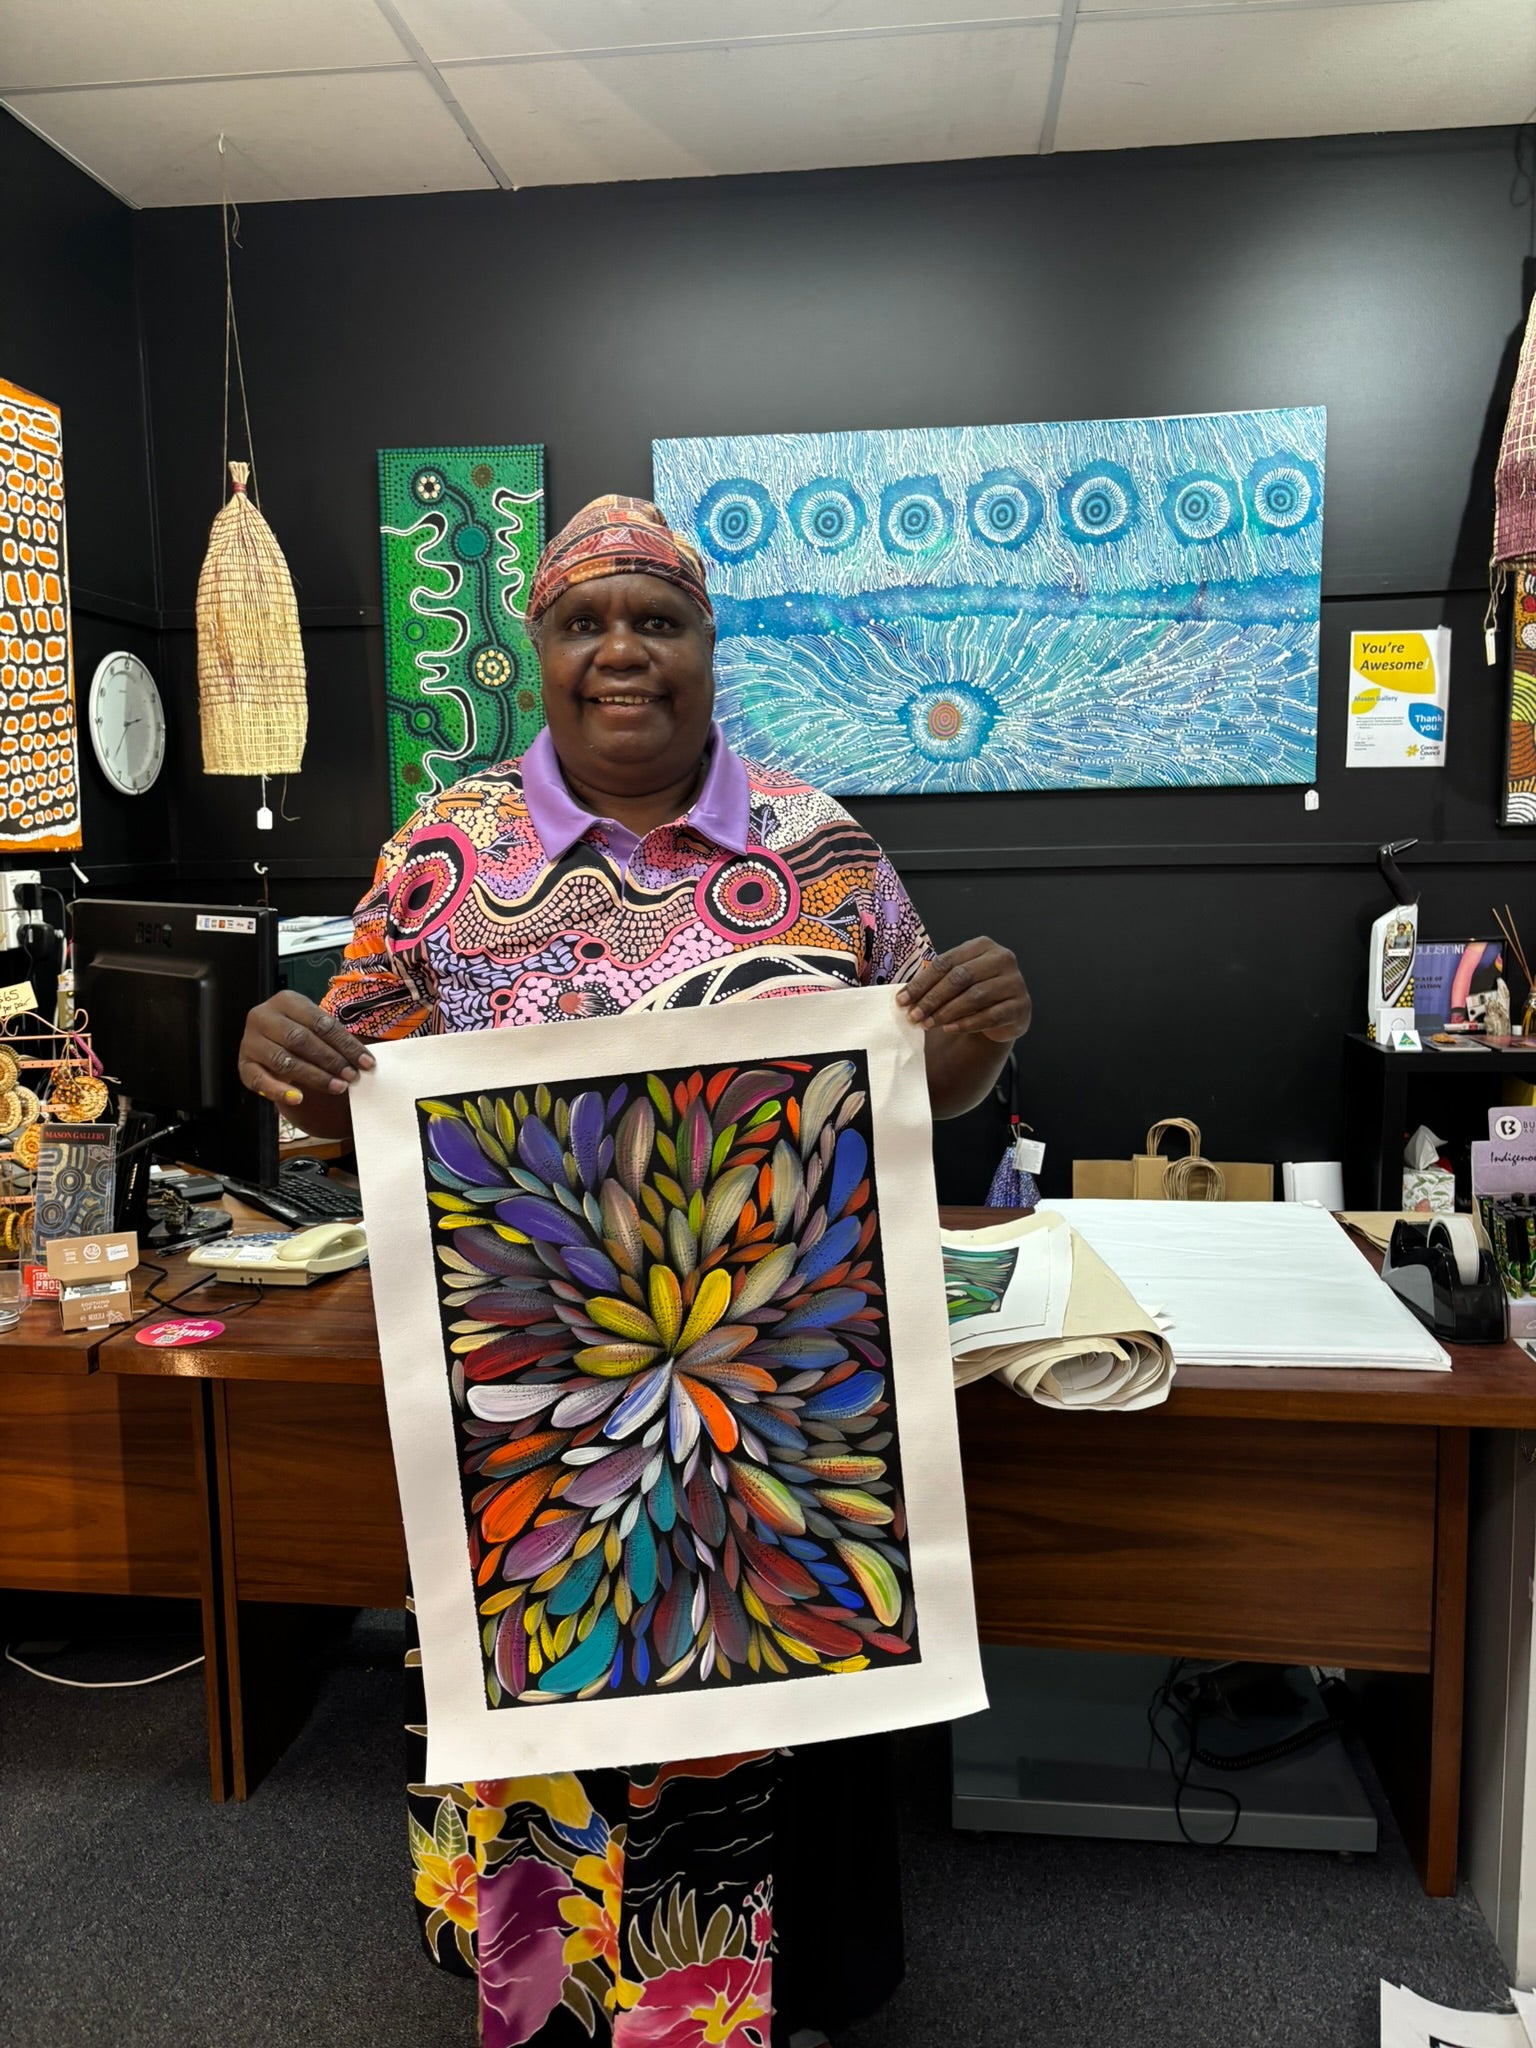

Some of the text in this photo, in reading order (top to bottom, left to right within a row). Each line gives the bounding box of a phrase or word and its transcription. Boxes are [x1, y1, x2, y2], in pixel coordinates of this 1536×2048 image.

[1362, 642, 1405, 654] You're
[1360, 658, 1430, 671] Awesome!
[1415, 714, 1443, 723] Thank
[1420, 724, 1440, 733] you.
[45, 1131, 105, 1140] MASON GALLERY
